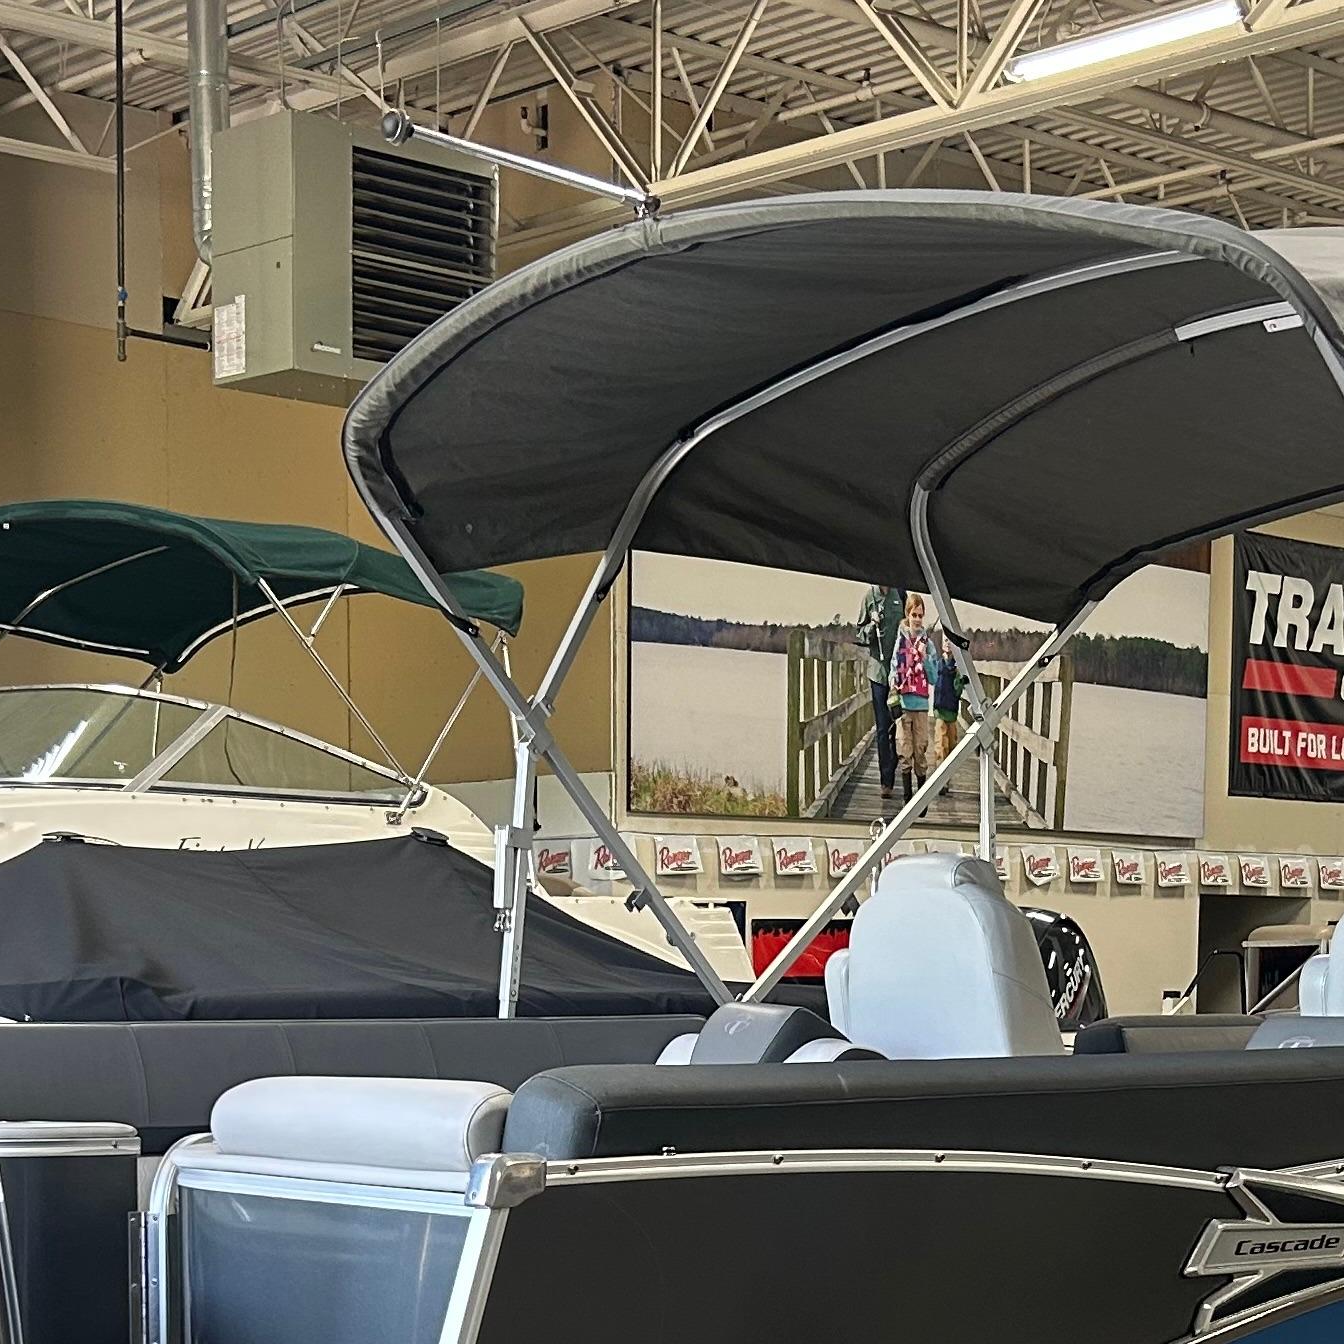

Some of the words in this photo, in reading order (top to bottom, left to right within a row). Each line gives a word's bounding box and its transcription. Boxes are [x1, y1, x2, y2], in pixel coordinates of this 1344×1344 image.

[1247, 727, 1292, 757] BUILT
[1297, 731, 1327, 760] FOR
[1054, 949, 1085, 1019] ERCURY
[1234, 1234, 1341, 1256] Cascade
